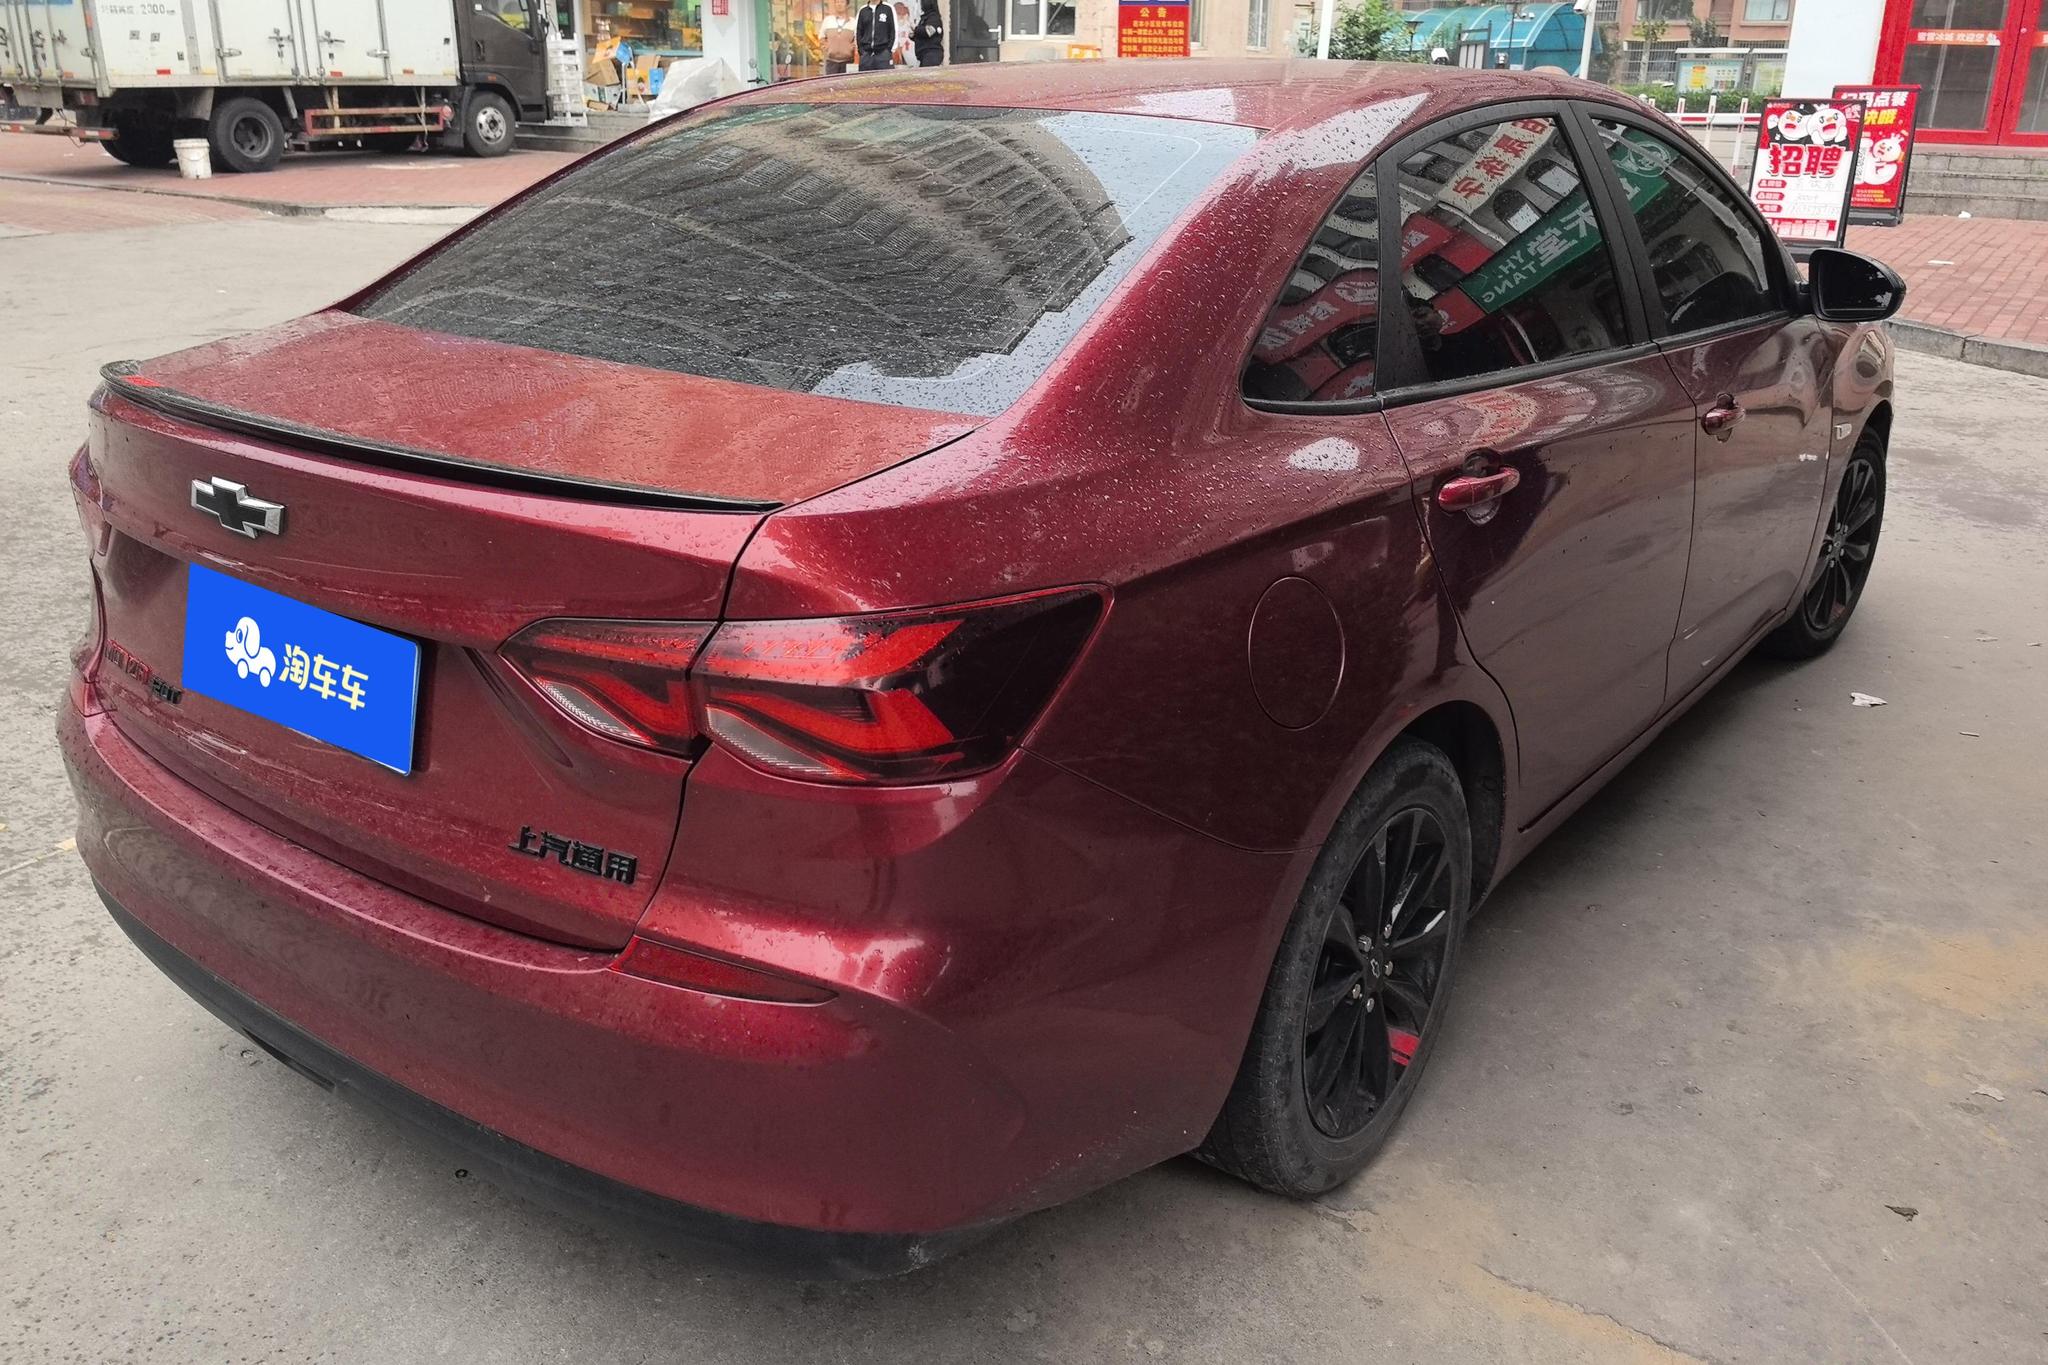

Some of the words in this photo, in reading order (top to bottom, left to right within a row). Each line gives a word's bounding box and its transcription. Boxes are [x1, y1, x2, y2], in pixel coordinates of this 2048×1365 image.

[1139, 7, 1167, 18] 公告
[1768, 142, 1845, 178] 招聘
[508, 824, 639, 885] 上汽通用
